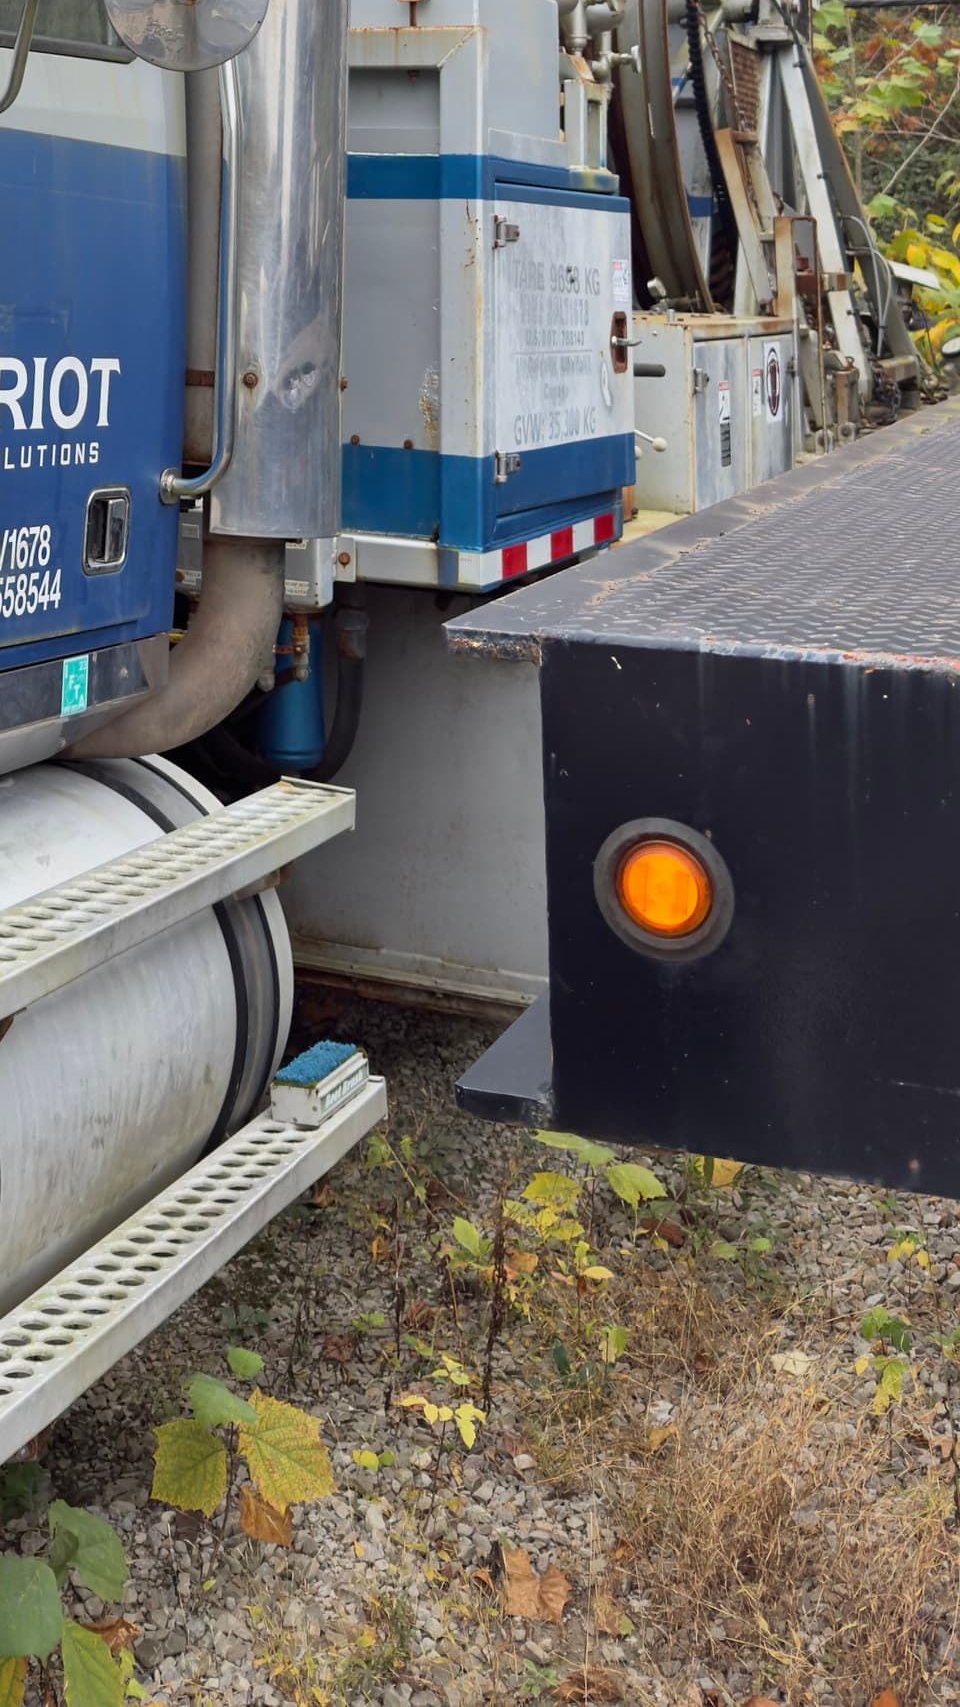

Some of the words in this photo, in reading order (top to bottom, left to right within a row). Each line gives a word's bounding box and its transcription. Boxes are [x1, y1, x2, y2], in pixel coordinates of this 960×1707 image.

[513, 260, 545, 290] TARE
[584, 267, 601, 296] KG
[583, 406, 597, 434] KG
